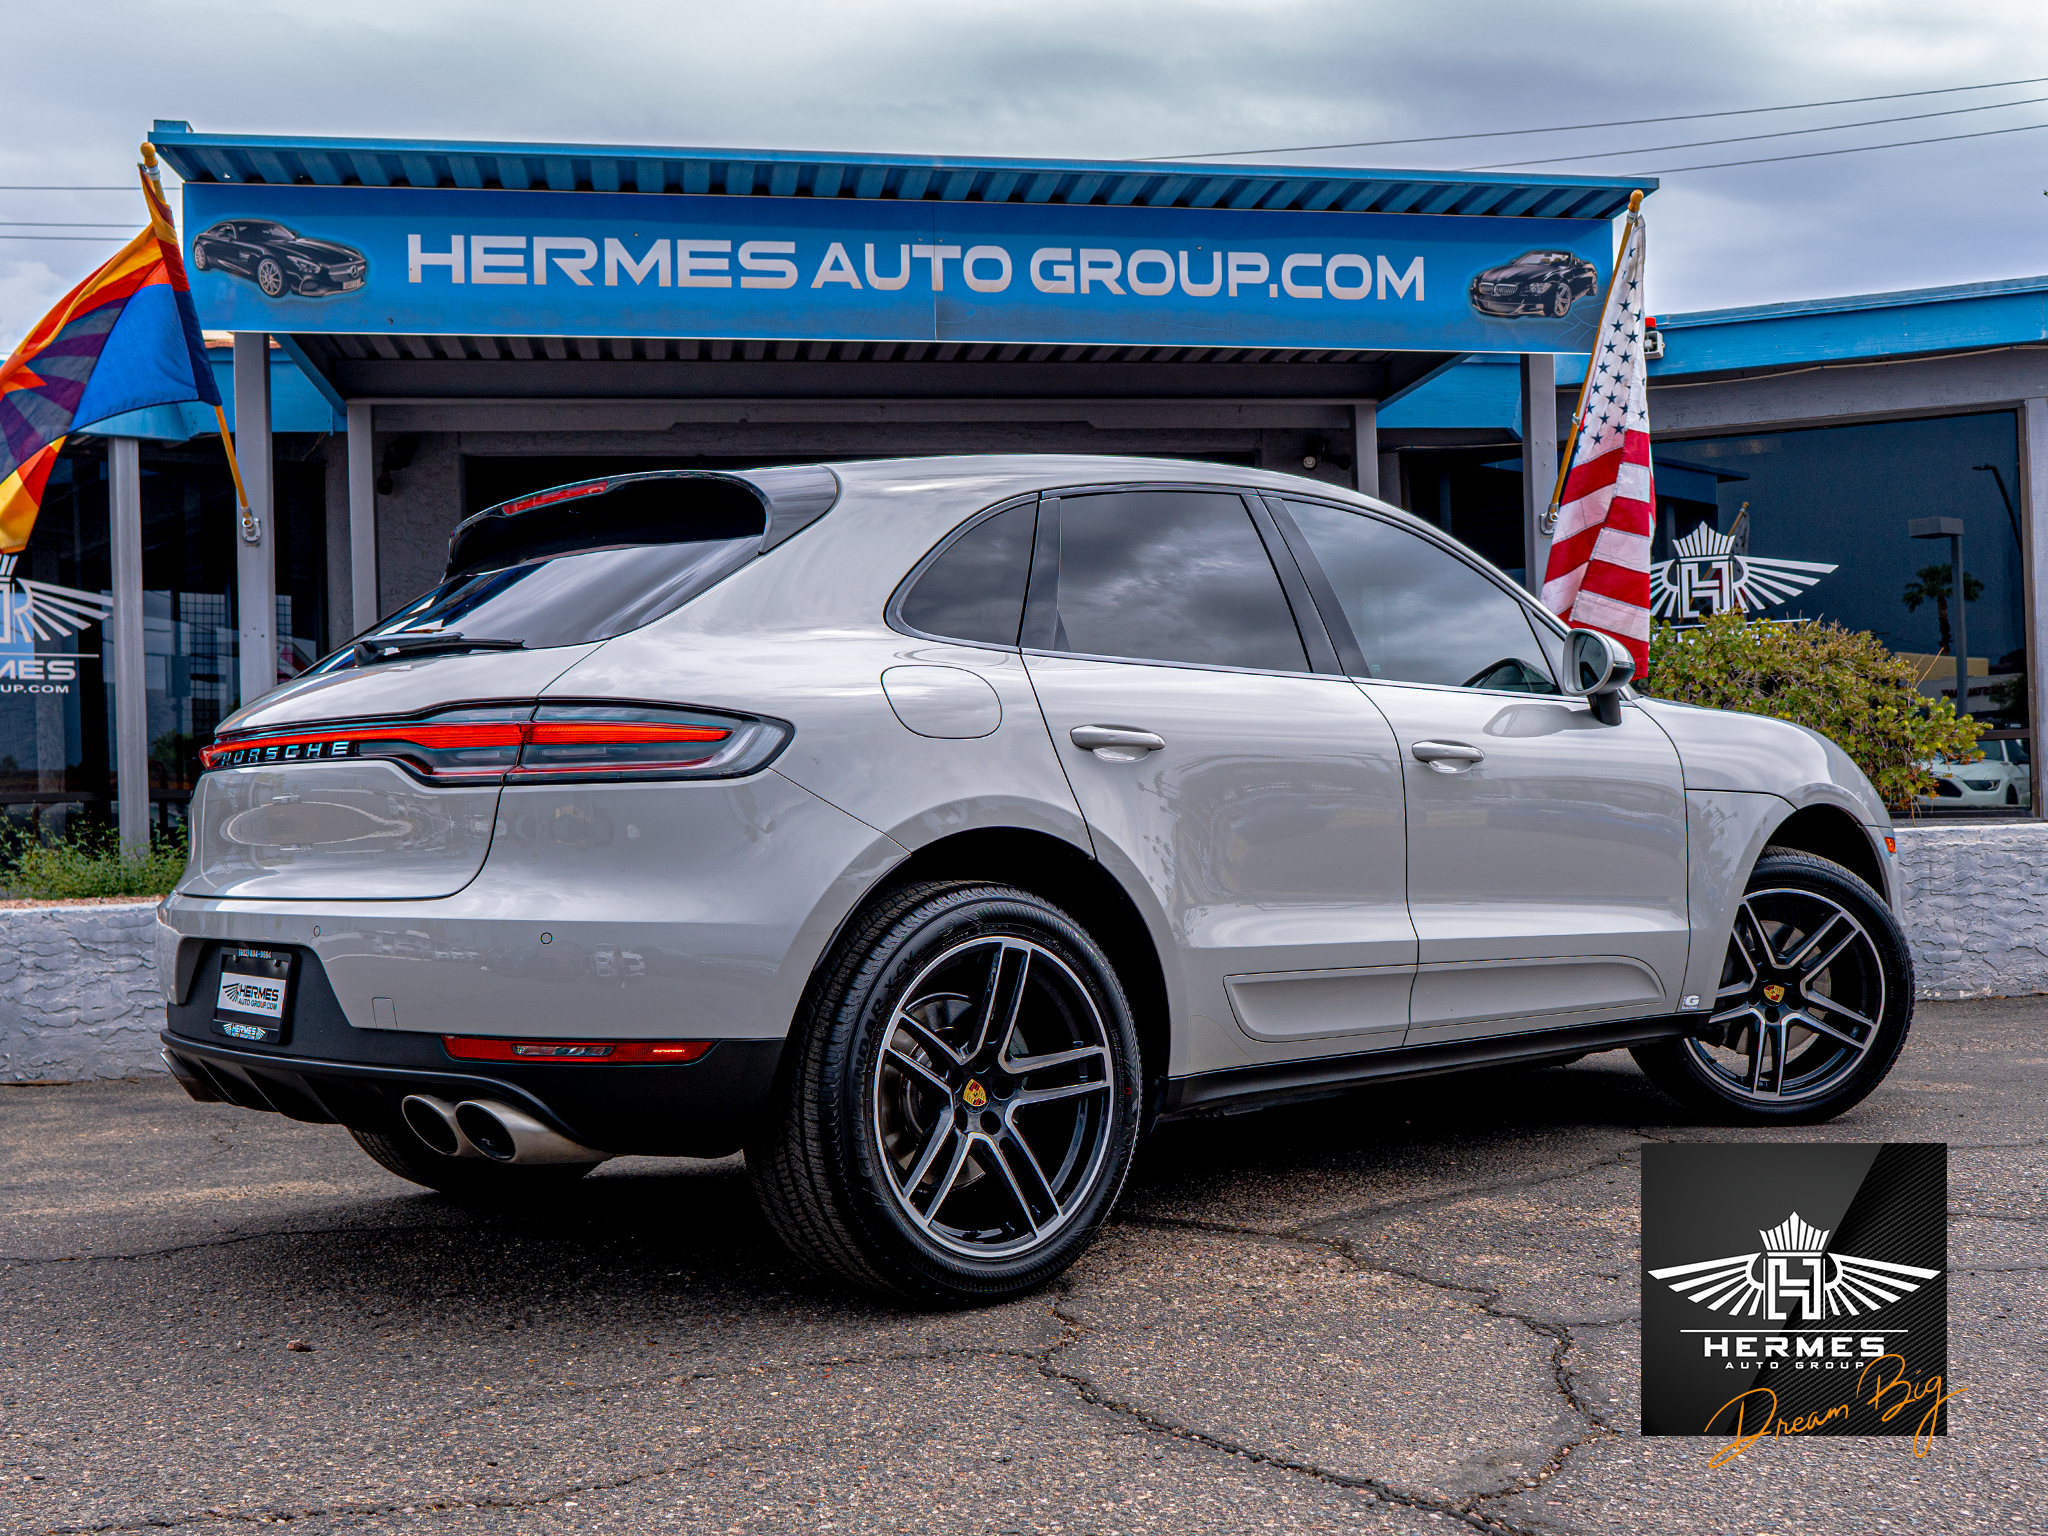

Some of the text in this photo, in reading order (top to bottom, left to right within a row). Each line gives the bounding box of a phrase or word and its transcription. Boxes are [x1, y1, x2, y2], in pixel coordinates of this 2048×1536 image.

[408, 233, 1425, 301] HERMES AUTO GROUP.COM
[221, 741, 350, 766] PORSCHE
[238, 984, 279, 1002] HERMES
[238, 998, 278, 1010] AUTO GROUP.COM
[231, 1023, 257, 1035] HERMES
